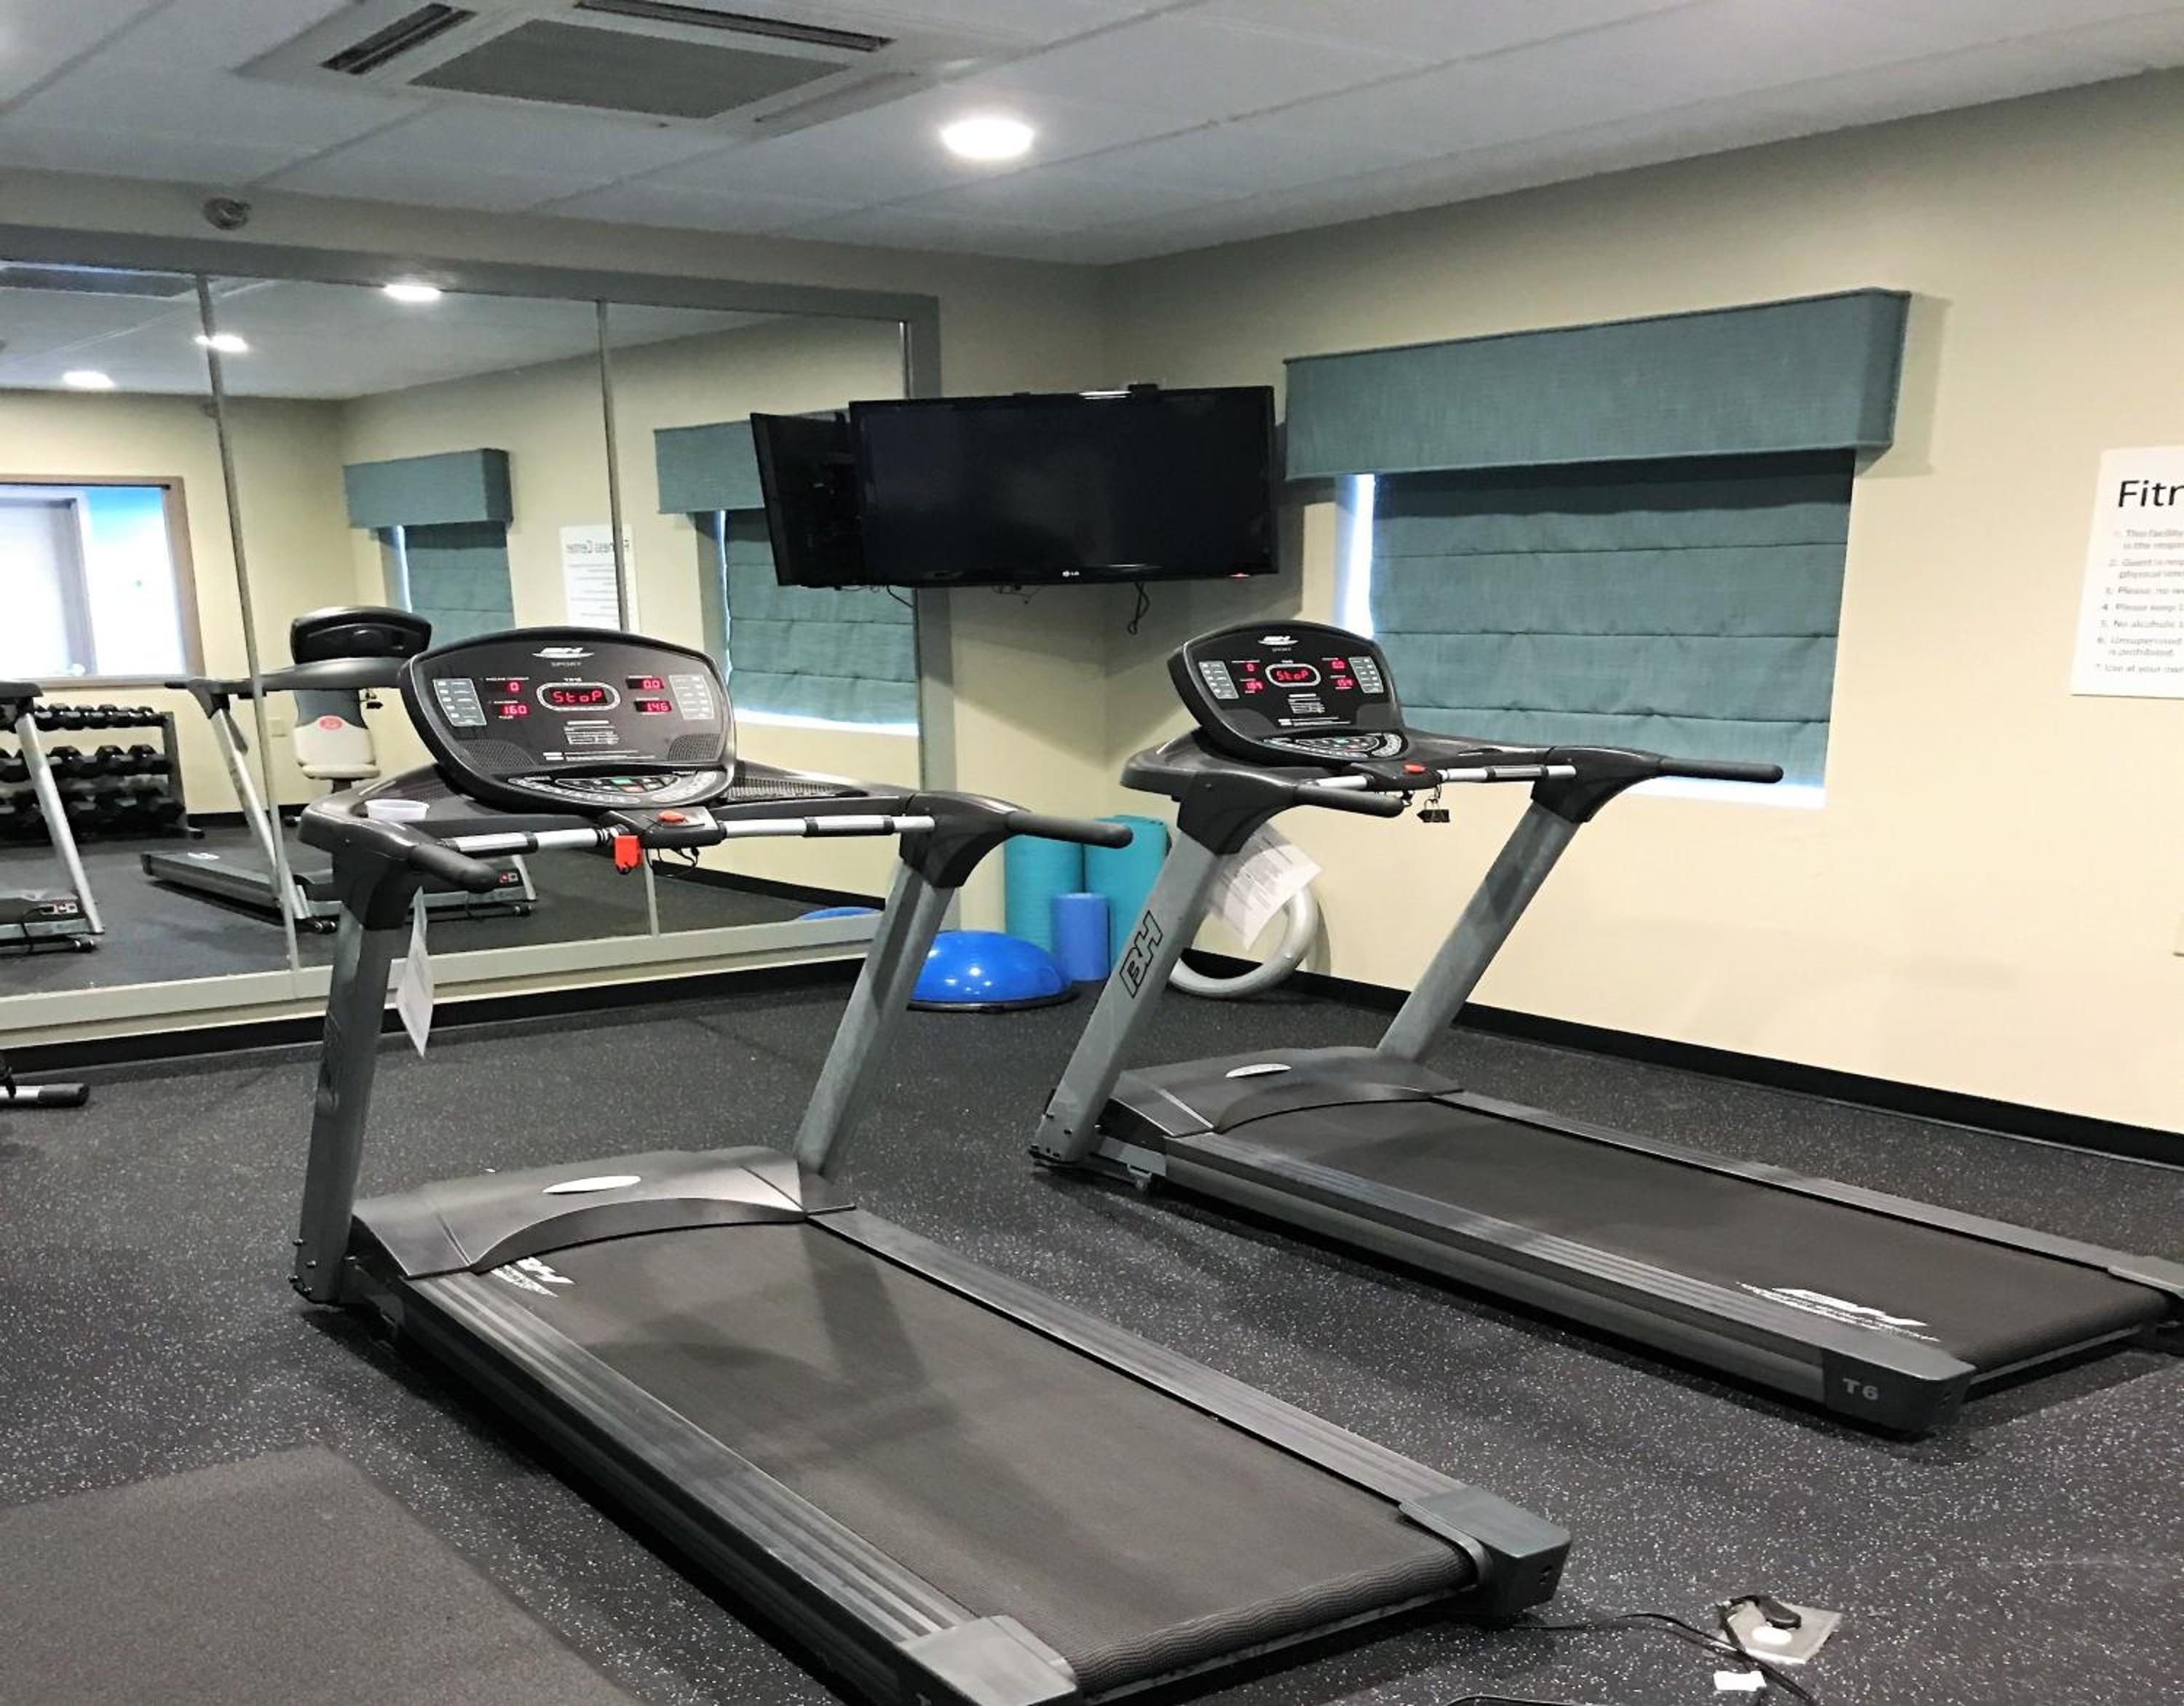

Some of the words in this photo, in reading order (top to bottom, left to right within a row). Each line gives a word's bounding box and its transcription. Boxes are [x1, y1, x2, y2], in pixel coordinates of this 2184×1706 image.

[510, 682, 520, 691] 0
[504, 705, 527, 715] 160
[1120, 910, 1163, 999] BH
[1843, 1378, 1879, 1400] T6
